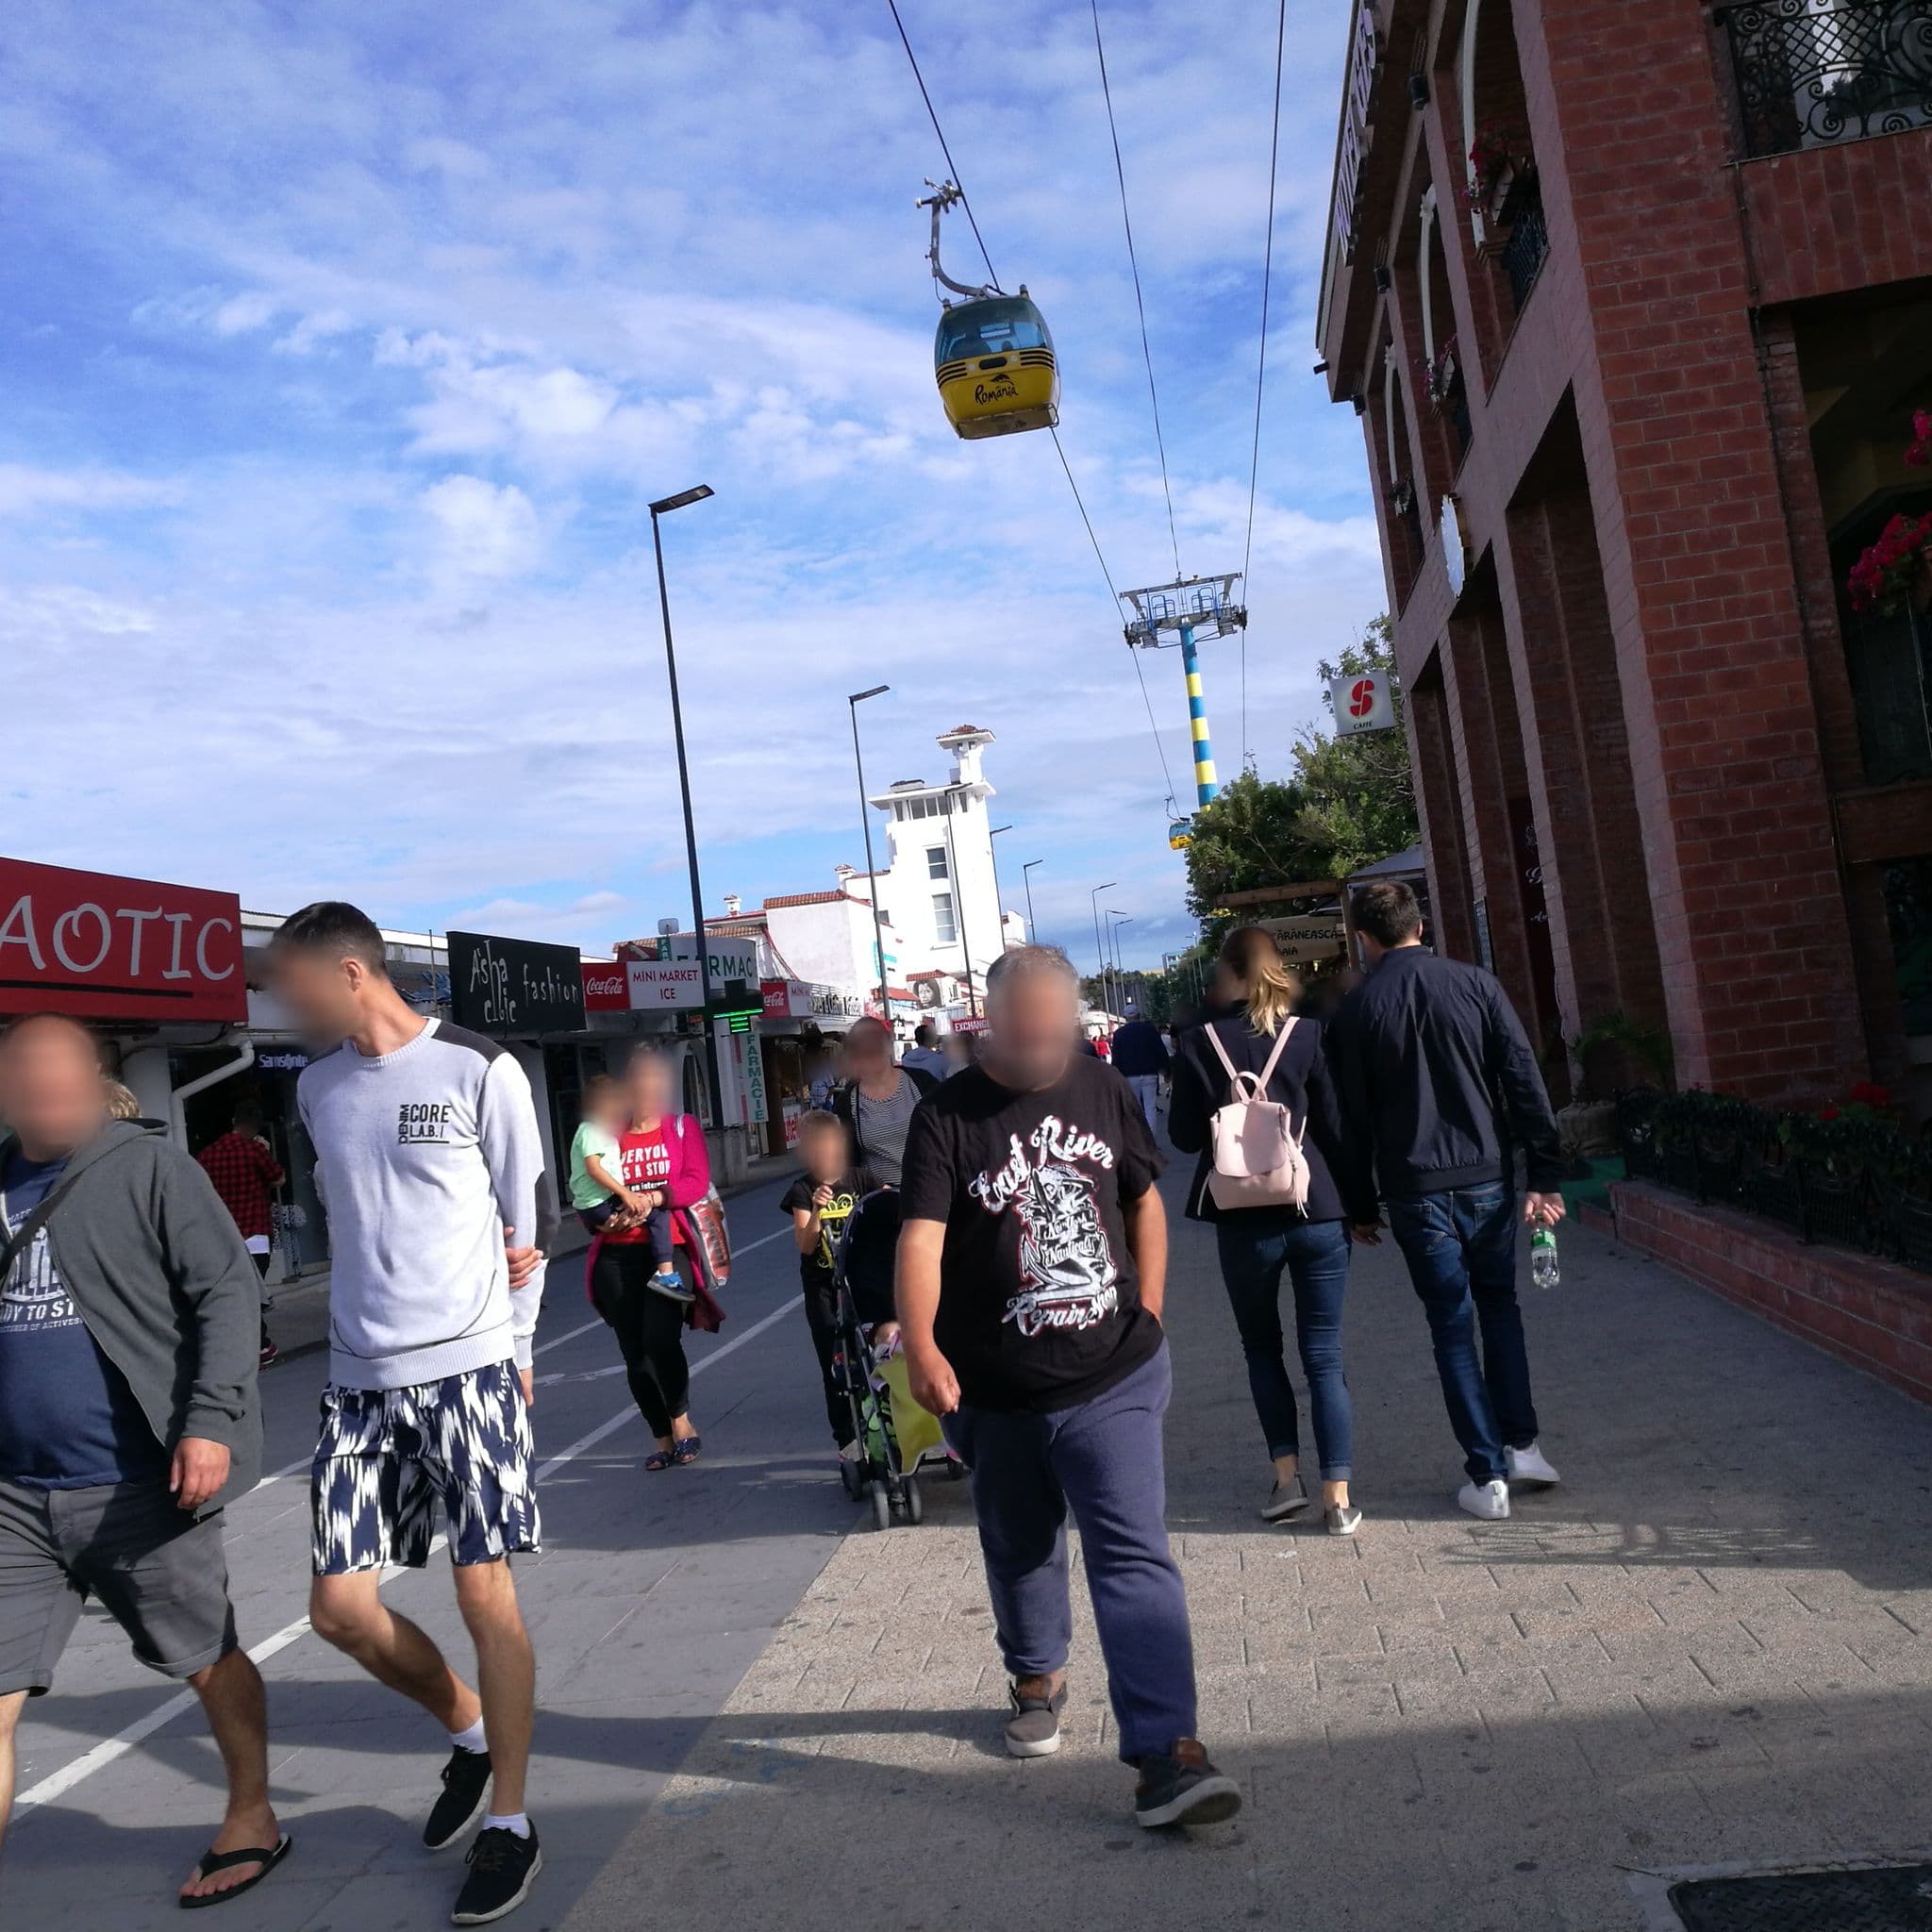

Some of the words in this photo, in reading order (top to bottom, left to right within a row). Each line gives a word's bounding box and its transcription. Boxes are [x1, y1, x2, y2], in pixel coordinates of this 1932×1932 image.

[0, 894, 235, 981] AOTIC
[523, 962, 578, 1008] fashion
[633, 971, 656, 982] MINI
[659, 969, 698, 982] MARKET
[660, 988, 676, 1000] ICE
[763, 991, 784, 1007] oca-Cola
[747, 1035, 765, 1121] FARMACIE
[409, 1104, 451, 1123] CORE
[398, 1104, 409, 1144] DENIM
[1030, 1115, 1114, 1170] River
[635, 1164, 642, 1178] A
[26, 1304, 47, 1321] TO
